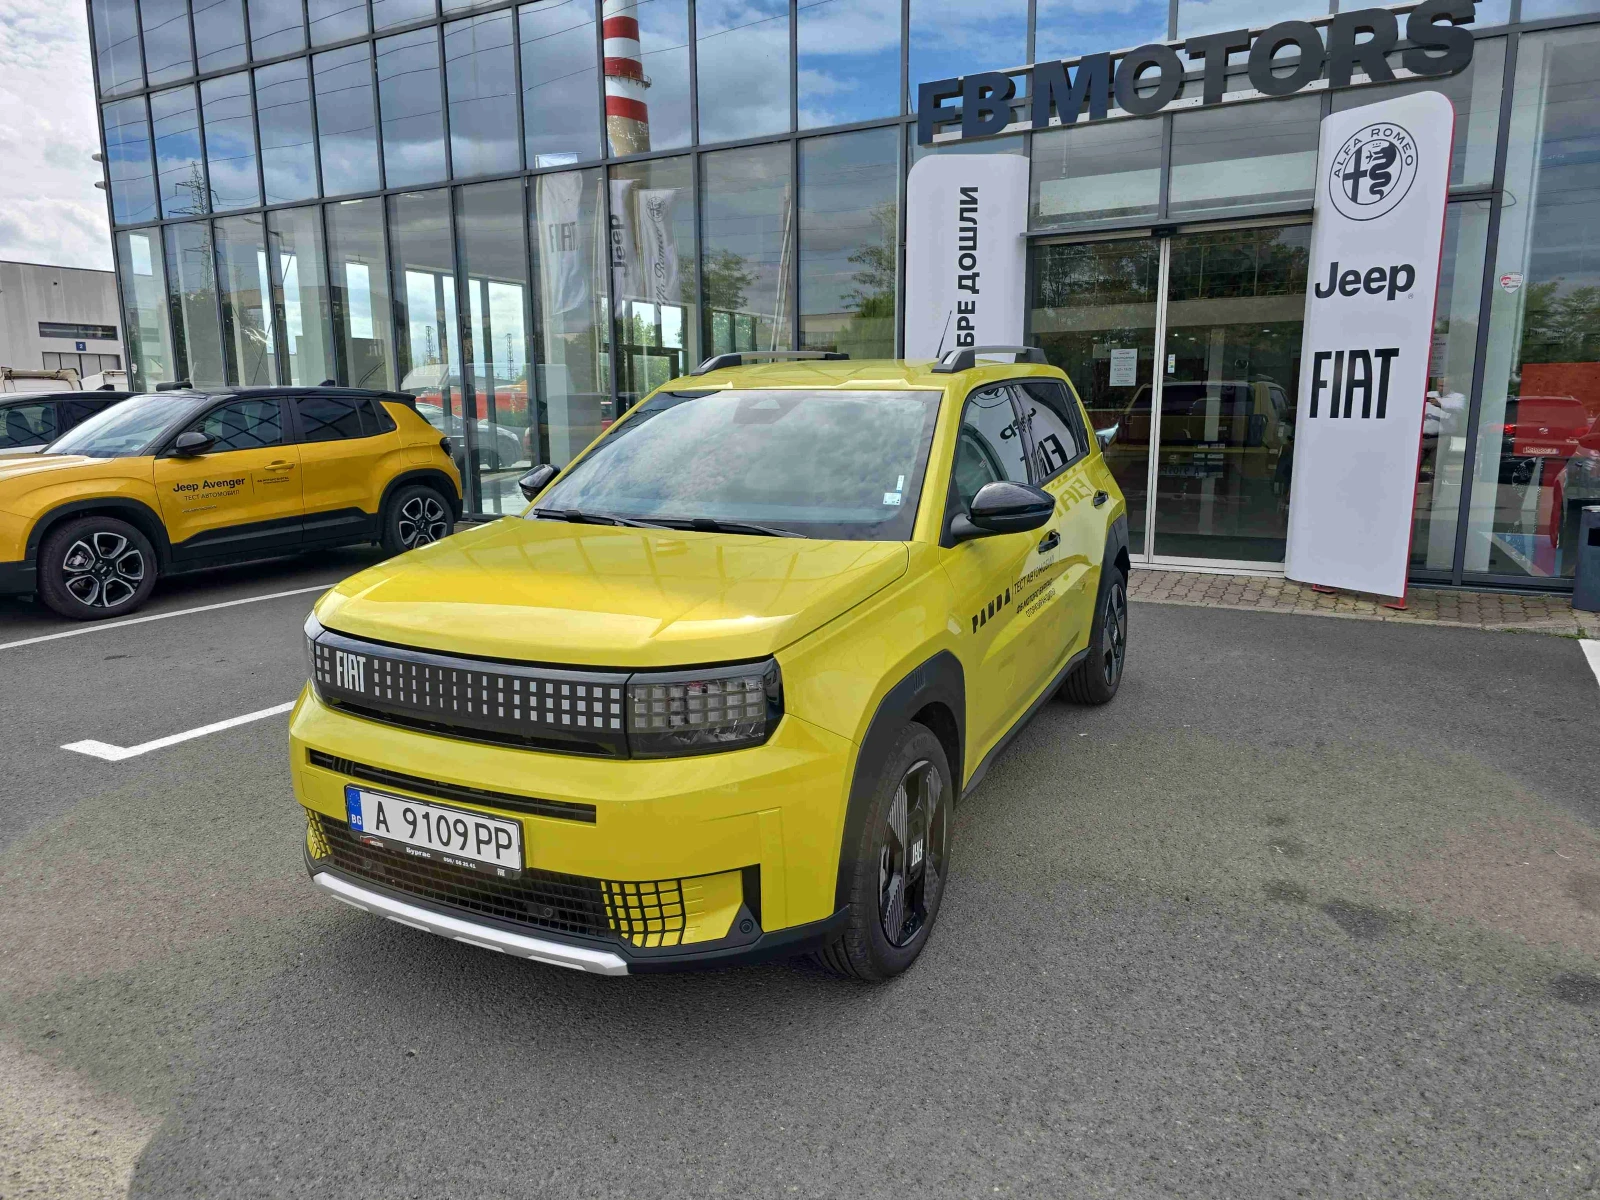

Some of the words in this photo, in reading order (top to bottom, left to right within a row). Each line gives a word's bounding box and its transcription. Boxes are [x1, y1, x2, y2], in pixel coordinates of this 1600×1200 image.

[917, 72, 1016, 146] FB
[1031, 0, 1476, 130] MOTORS
[1334, 137, 1362, 178] ALFA
[1371, 128, 1414, 166] ROMEO
[611, 214, 630, 278] Jeep
[654, 227, 665, 279] Romeo
[958, 186, 980, 294] ДОШЛИ
[1314, 261, 1416, 301] Jeep
[1309, 347, 1400, 419] FIAT
[173, 483, 199, 493] Jeep
[202, 477, 246, 489] Avenger
[1014, 575, 1027, 594] ТЕСТ
[971, 587, 1011, 635] PANDA
[336, 650, 367, 693] FIAT
[351, 813, 363, 826] BG
[375, 800, 391, 833] A
